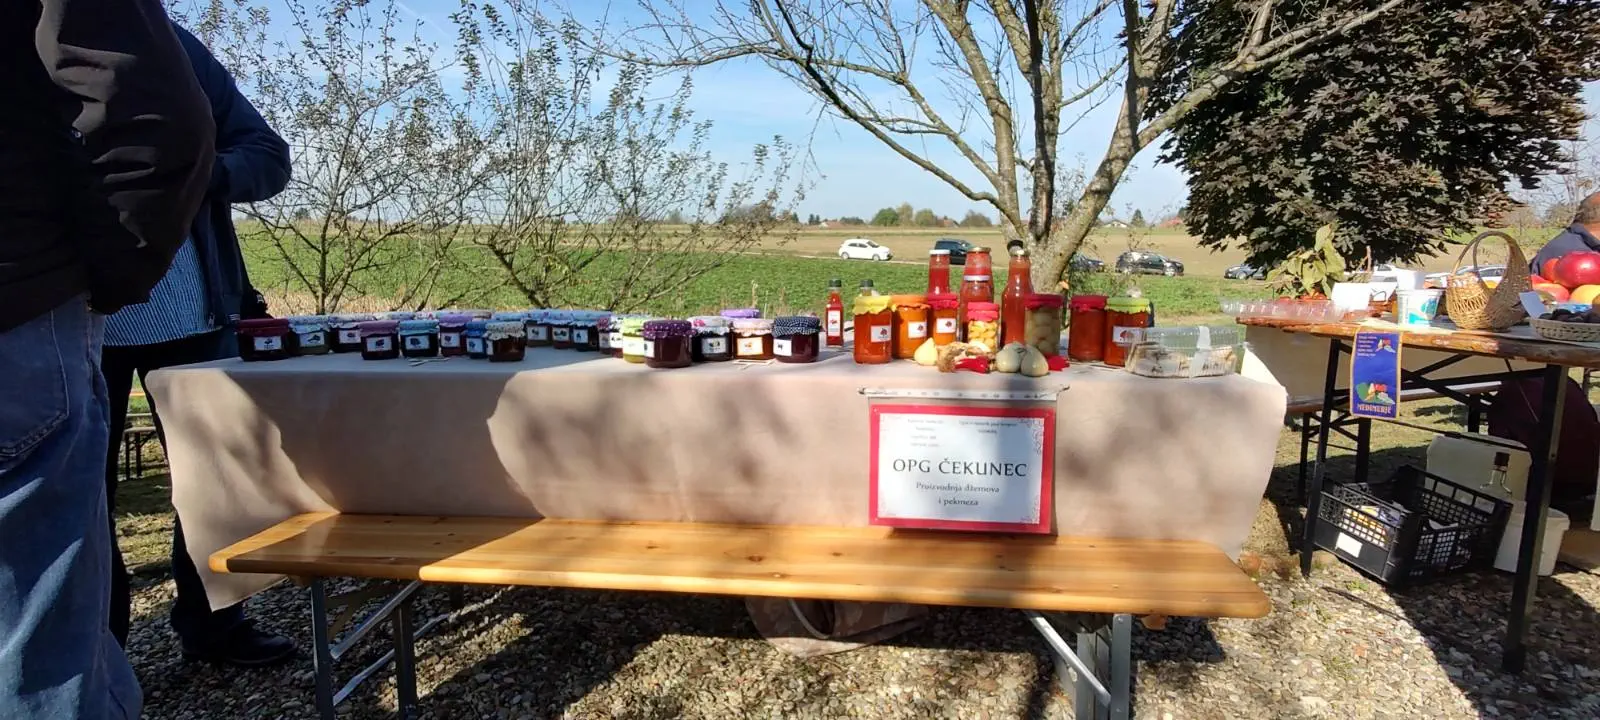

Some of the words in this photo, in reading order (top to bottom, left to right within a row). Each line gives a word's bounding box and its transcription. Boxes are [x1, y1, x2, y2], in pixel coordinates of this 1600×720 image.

[893, 458, 931, 473] OPG
[938, 457, 1028, 477] ČEKUNEC
[916, 481, 962, 493] Proizvodnja
[964, 483, 1000, 493] džemova
[943, 498, 979, 507] pekmeza
